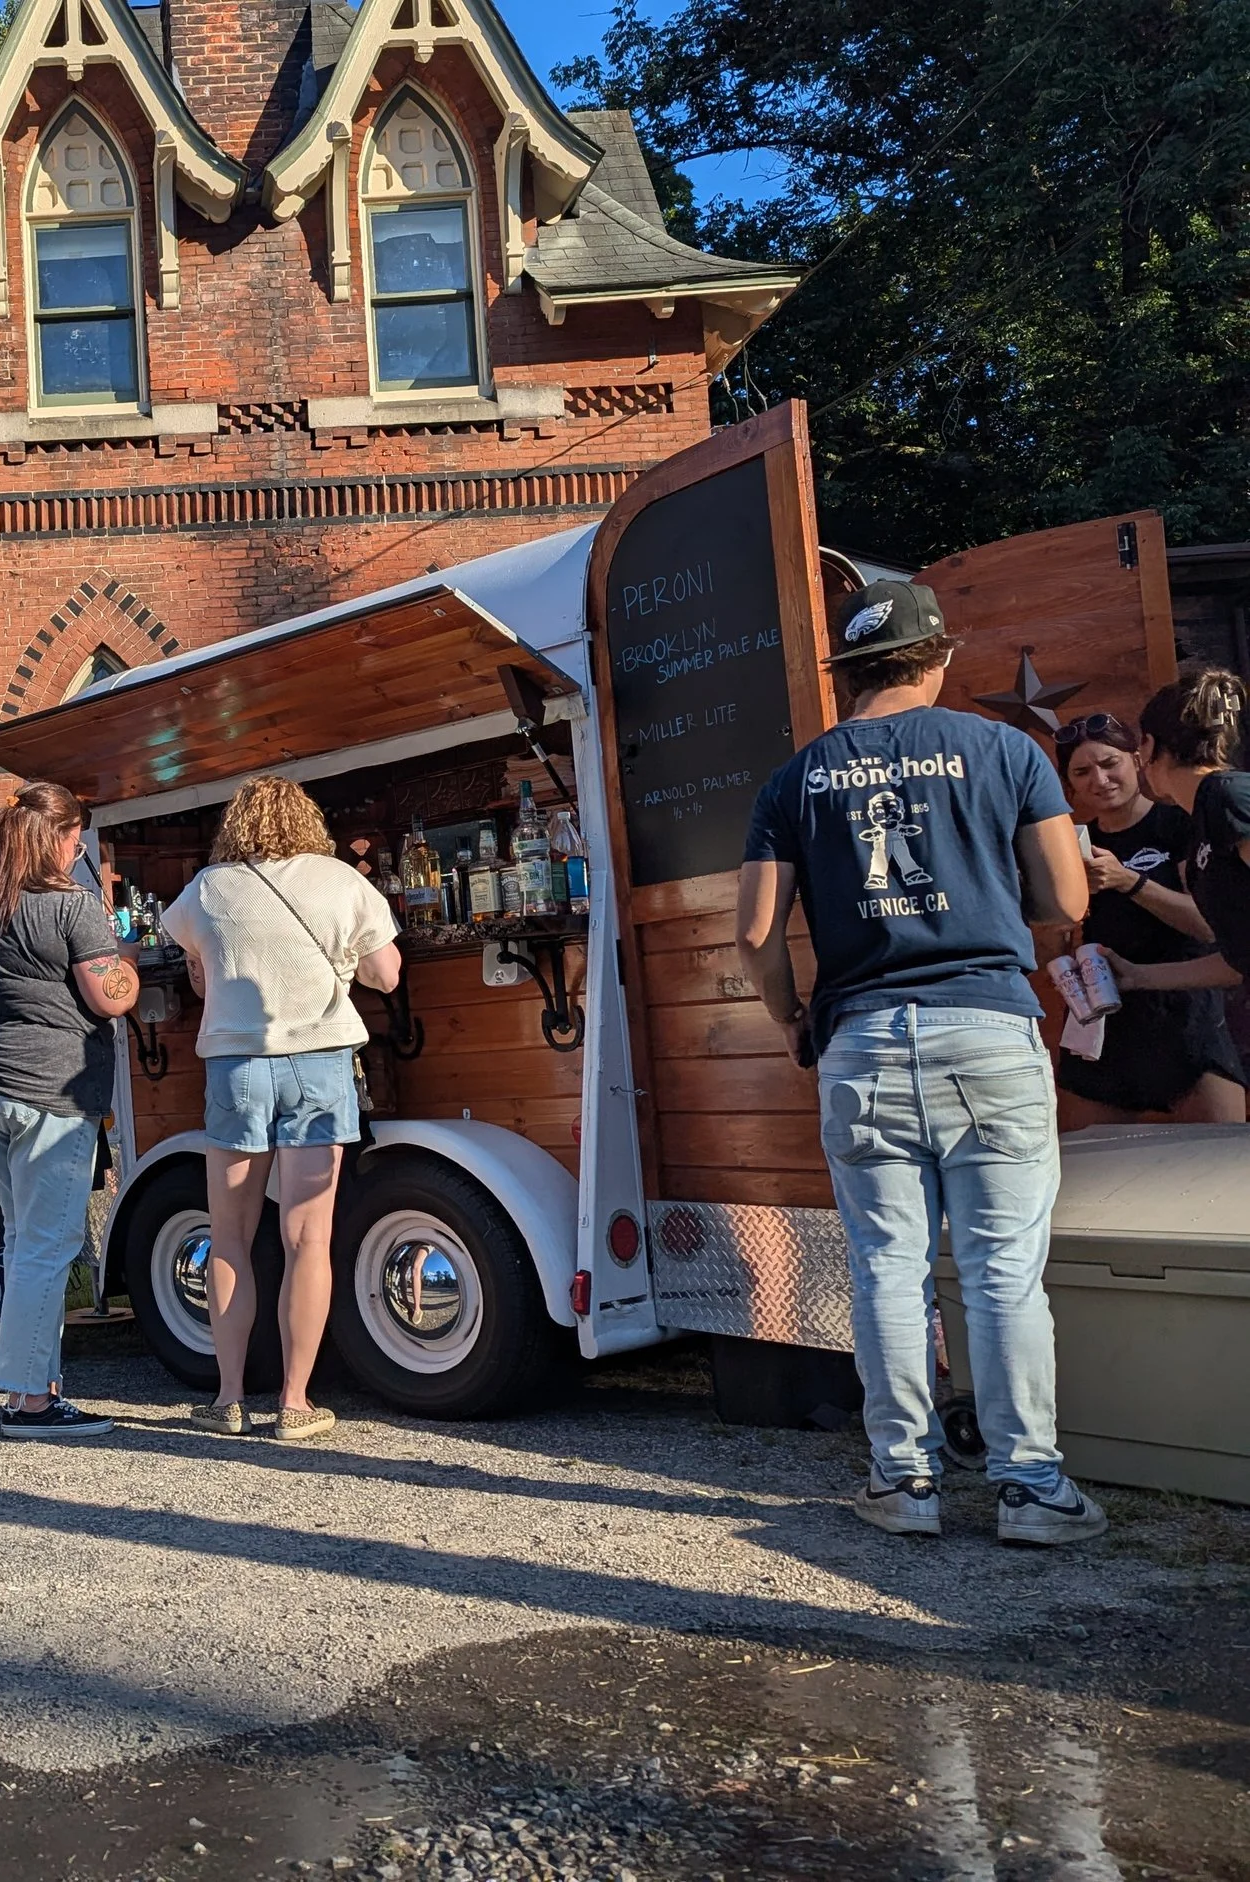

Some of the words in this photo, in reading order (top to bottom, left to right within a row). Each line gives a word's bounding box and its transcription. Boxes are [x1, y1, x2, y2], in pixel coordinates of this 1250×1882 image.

[623, 561, 713, 620] PERONI
[622, 617, 715, 672] BROOKLYN
[657, 650, 714, 684] SUMMER
[718, 636, 750, 660] PALE
[756, 628, 780, 650] ALE
[639, 713, 697, 746] MILLER
[705, 703, 736, 726] LITE
[807, 753, 964, 795] Stronghold
[847, 757, 882, 767] THE
[644, 783, 696, 807] ARNOLD
[702, 770, 751, 791] PALMER
[846, 811, 864, 821] EST.
[910, 803, 929, 814] 1895
[857, 896, 924, 918] VENICE,
[925, 892, 950, 912] CA
